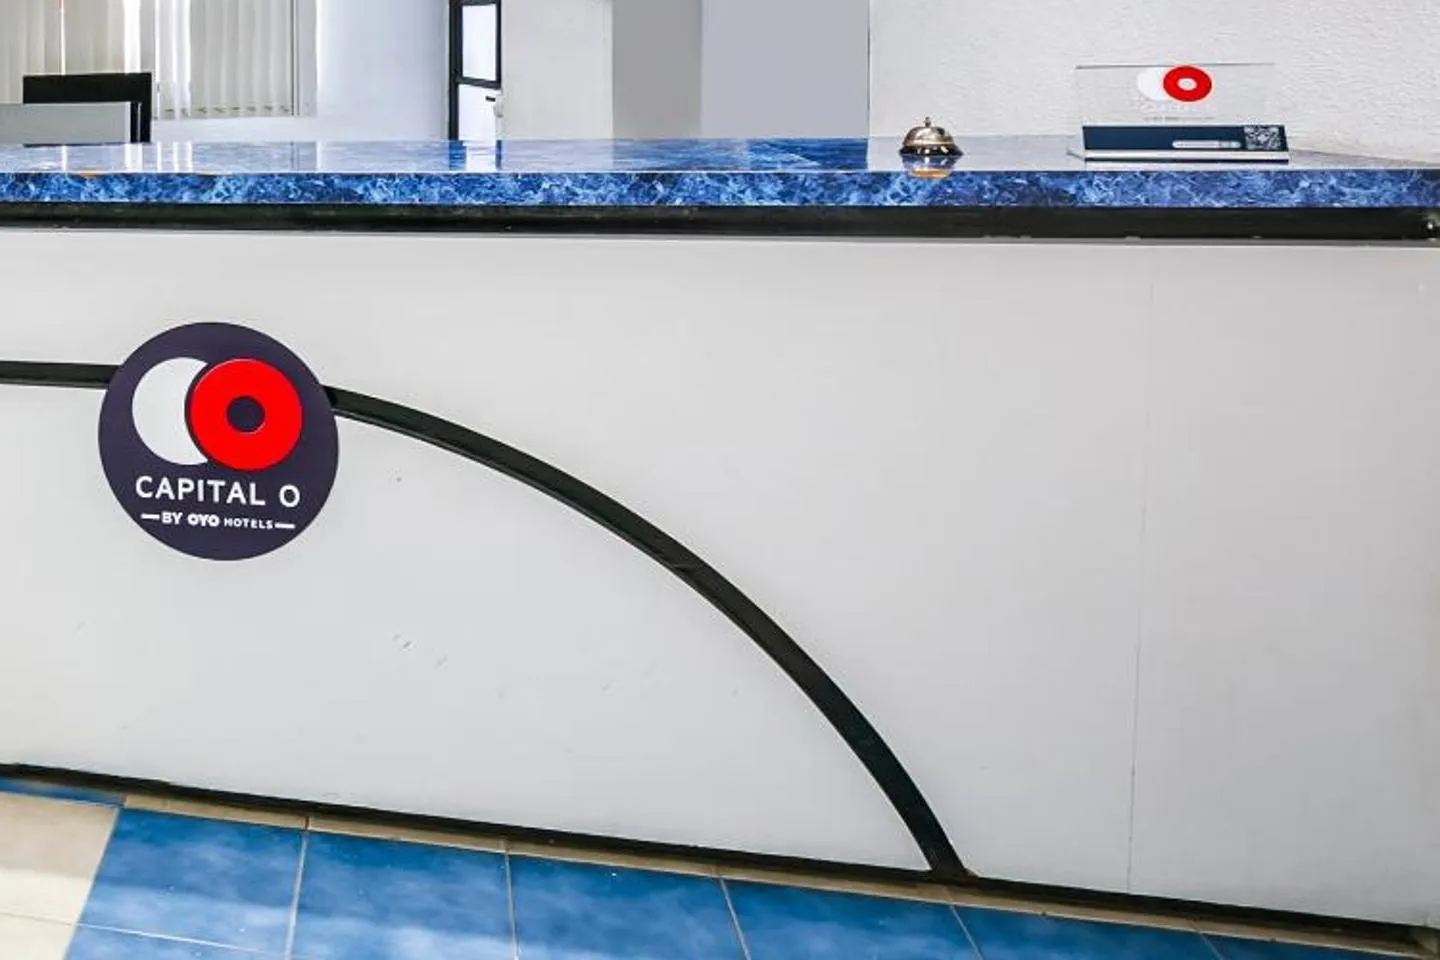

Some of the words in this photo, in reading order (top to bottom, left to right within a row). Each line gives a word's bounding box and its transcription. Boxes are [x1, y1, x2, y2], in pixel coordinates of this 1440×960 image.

[135, 475, 266, 506] CAPITAL
[278, 484, 301, 508] O
[161, 511, 183, 525] BY
[187, 513, 220, 528] OYO
[223, 517, 274, 530] HOTELS
